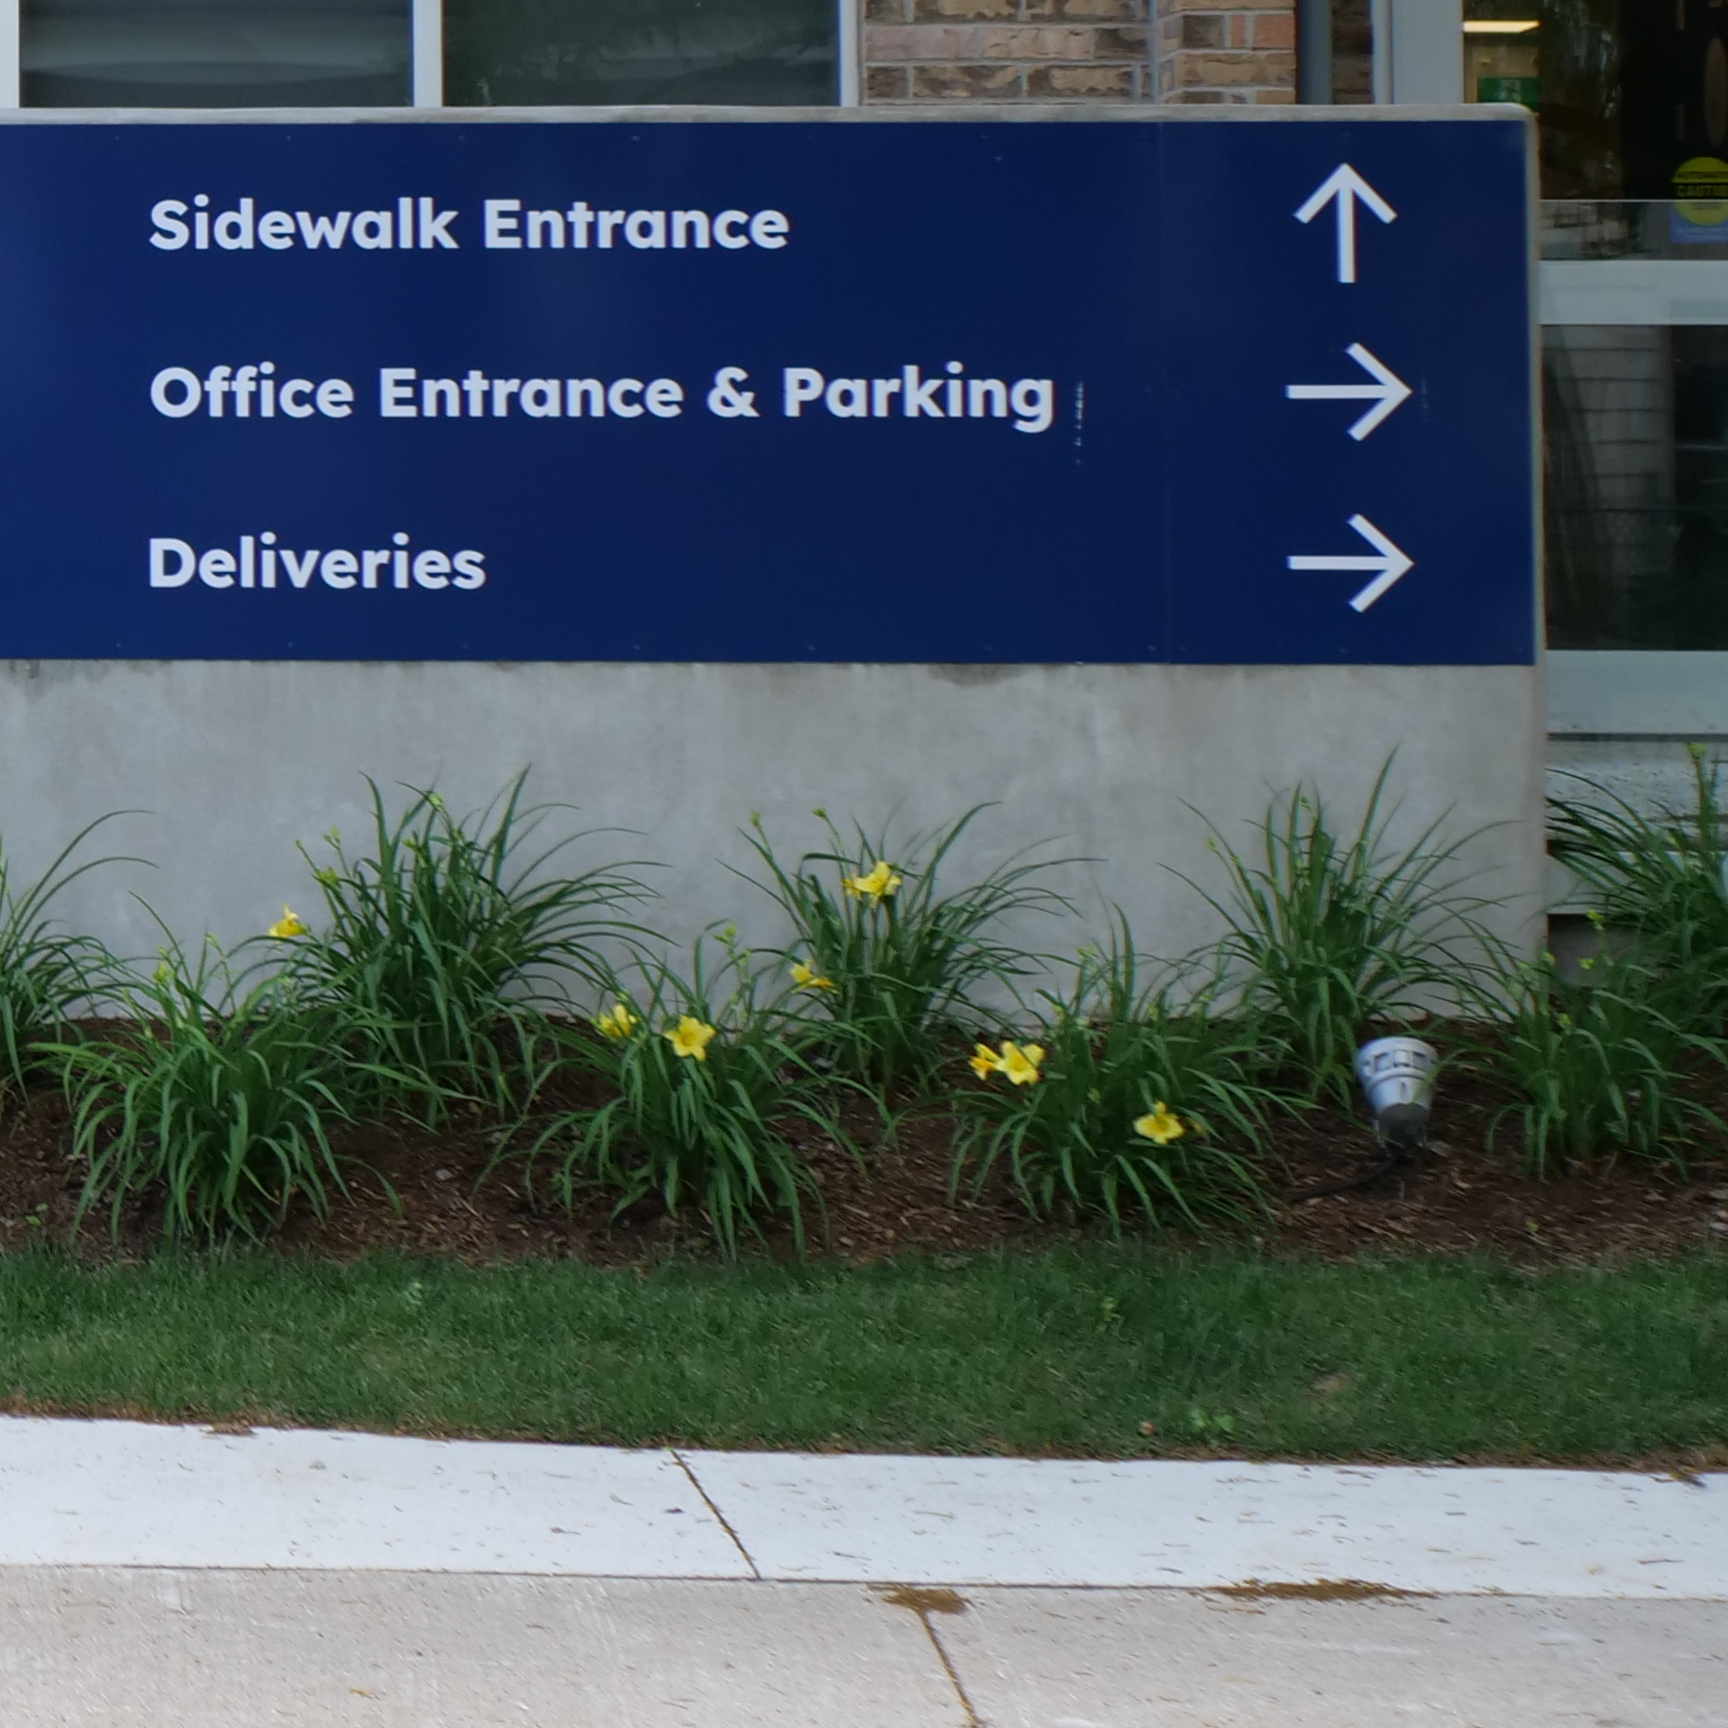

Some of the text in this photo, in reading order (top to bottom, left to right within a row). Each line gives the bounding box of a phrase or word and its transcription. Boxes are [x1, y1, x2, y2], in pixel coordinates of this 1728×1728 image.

[149, 193, 790, 251] Sidewalk Entrance
[149, 360, 1055, 434] Office Entrance & Parking
[149, 531, 487, 590] Deliveries
